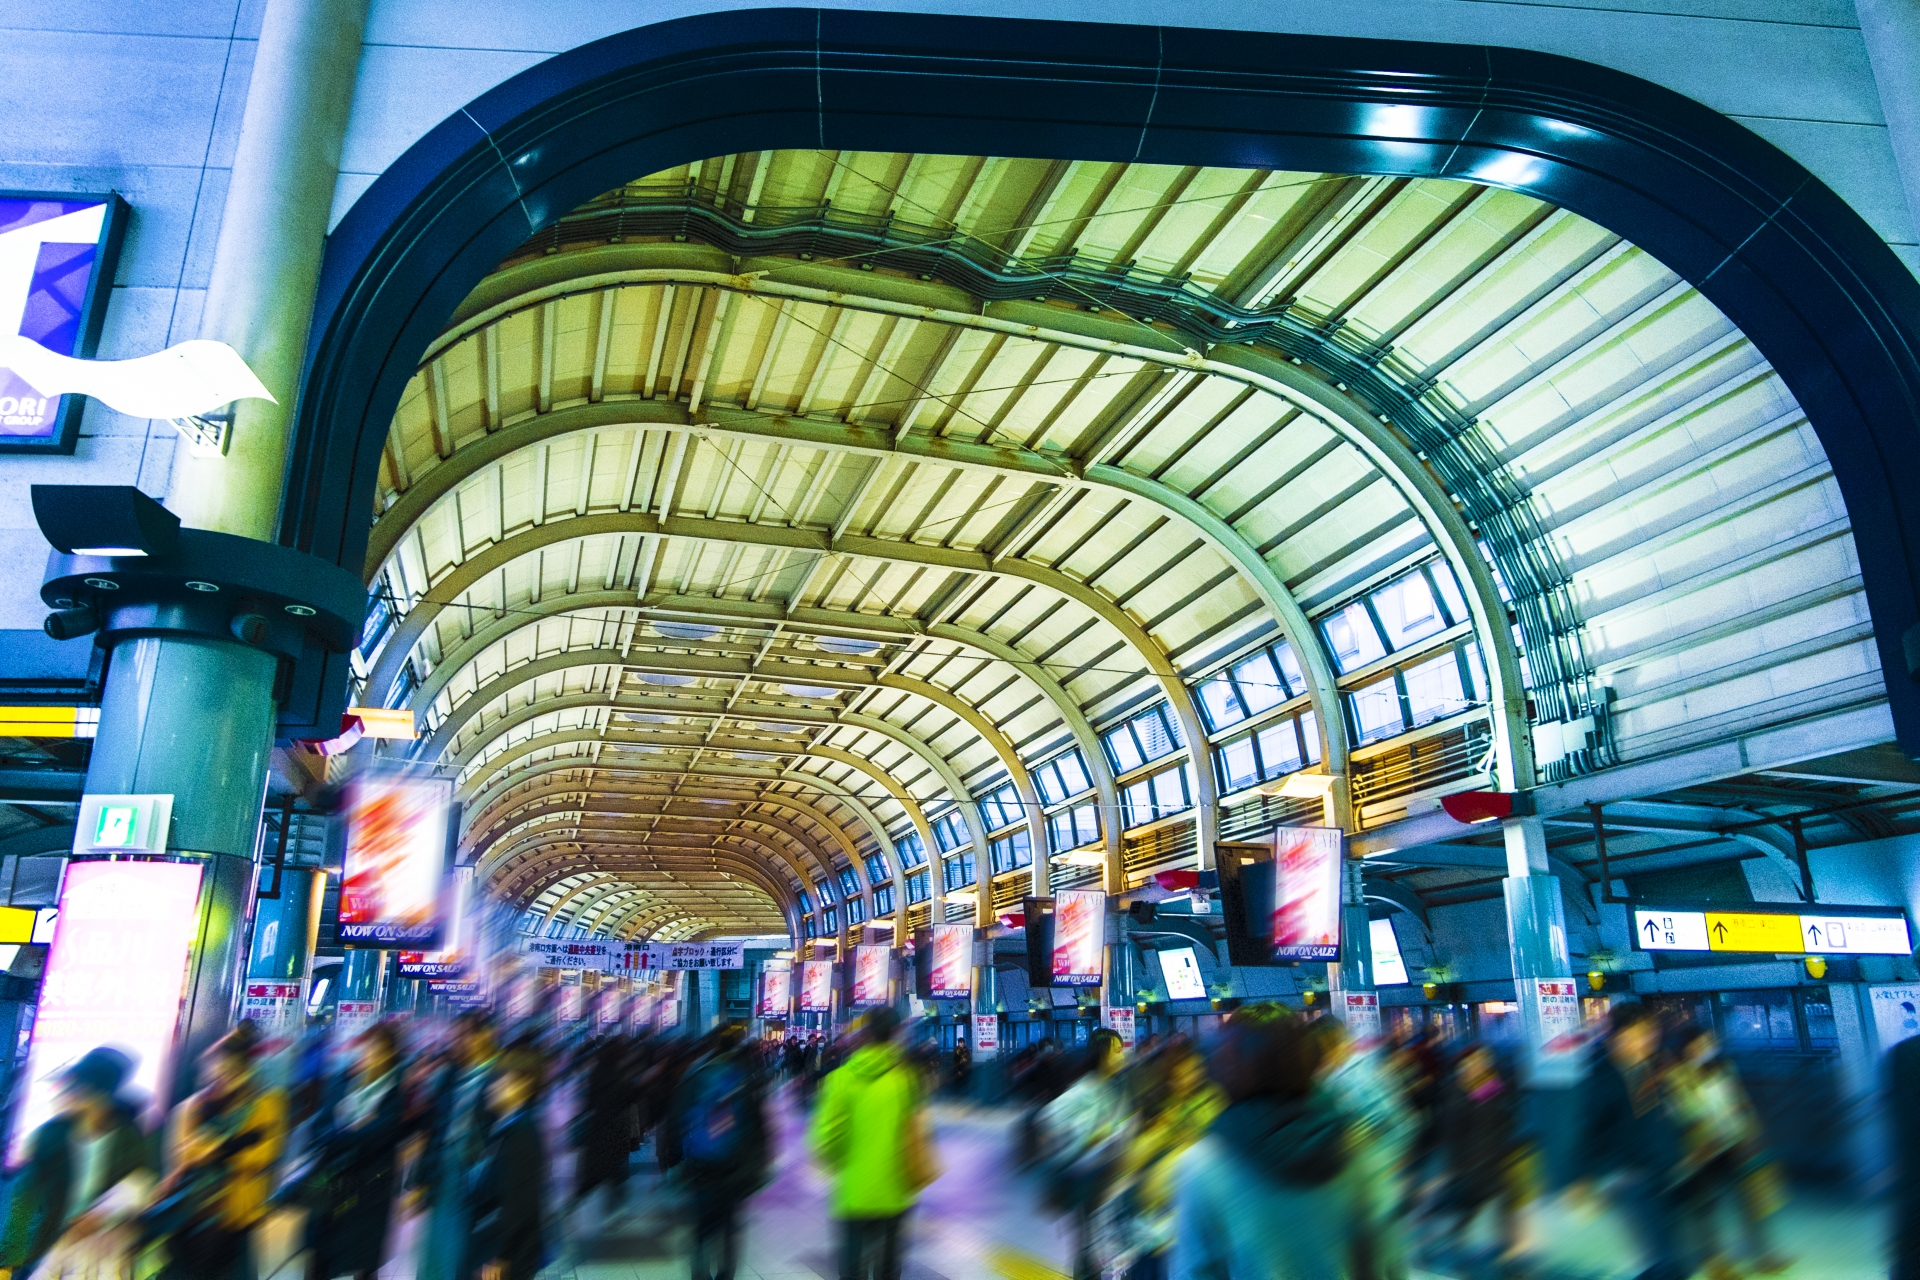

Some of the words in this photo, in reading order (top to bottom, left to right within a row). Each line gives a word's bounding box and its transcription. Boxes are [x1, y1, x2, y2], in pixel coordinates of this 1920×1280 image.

[341, 925, 376, 937] NOW
[375, 926, 397, 936] ON
[80, 931, 156, 965] 品川
[1277, 946, 1300, 956] NOW
[1298, 947, 1313, 956] ON
[1312, 947, 1336, 957] SALE!
[400, 964, 426, 973] NOW
[424, 964, 438, 973] ON
[1054, 975, 1072, 983] NOW
[1070, 975, 1082, 983] ON
[41, 969, 173, 1007] 美容外科
